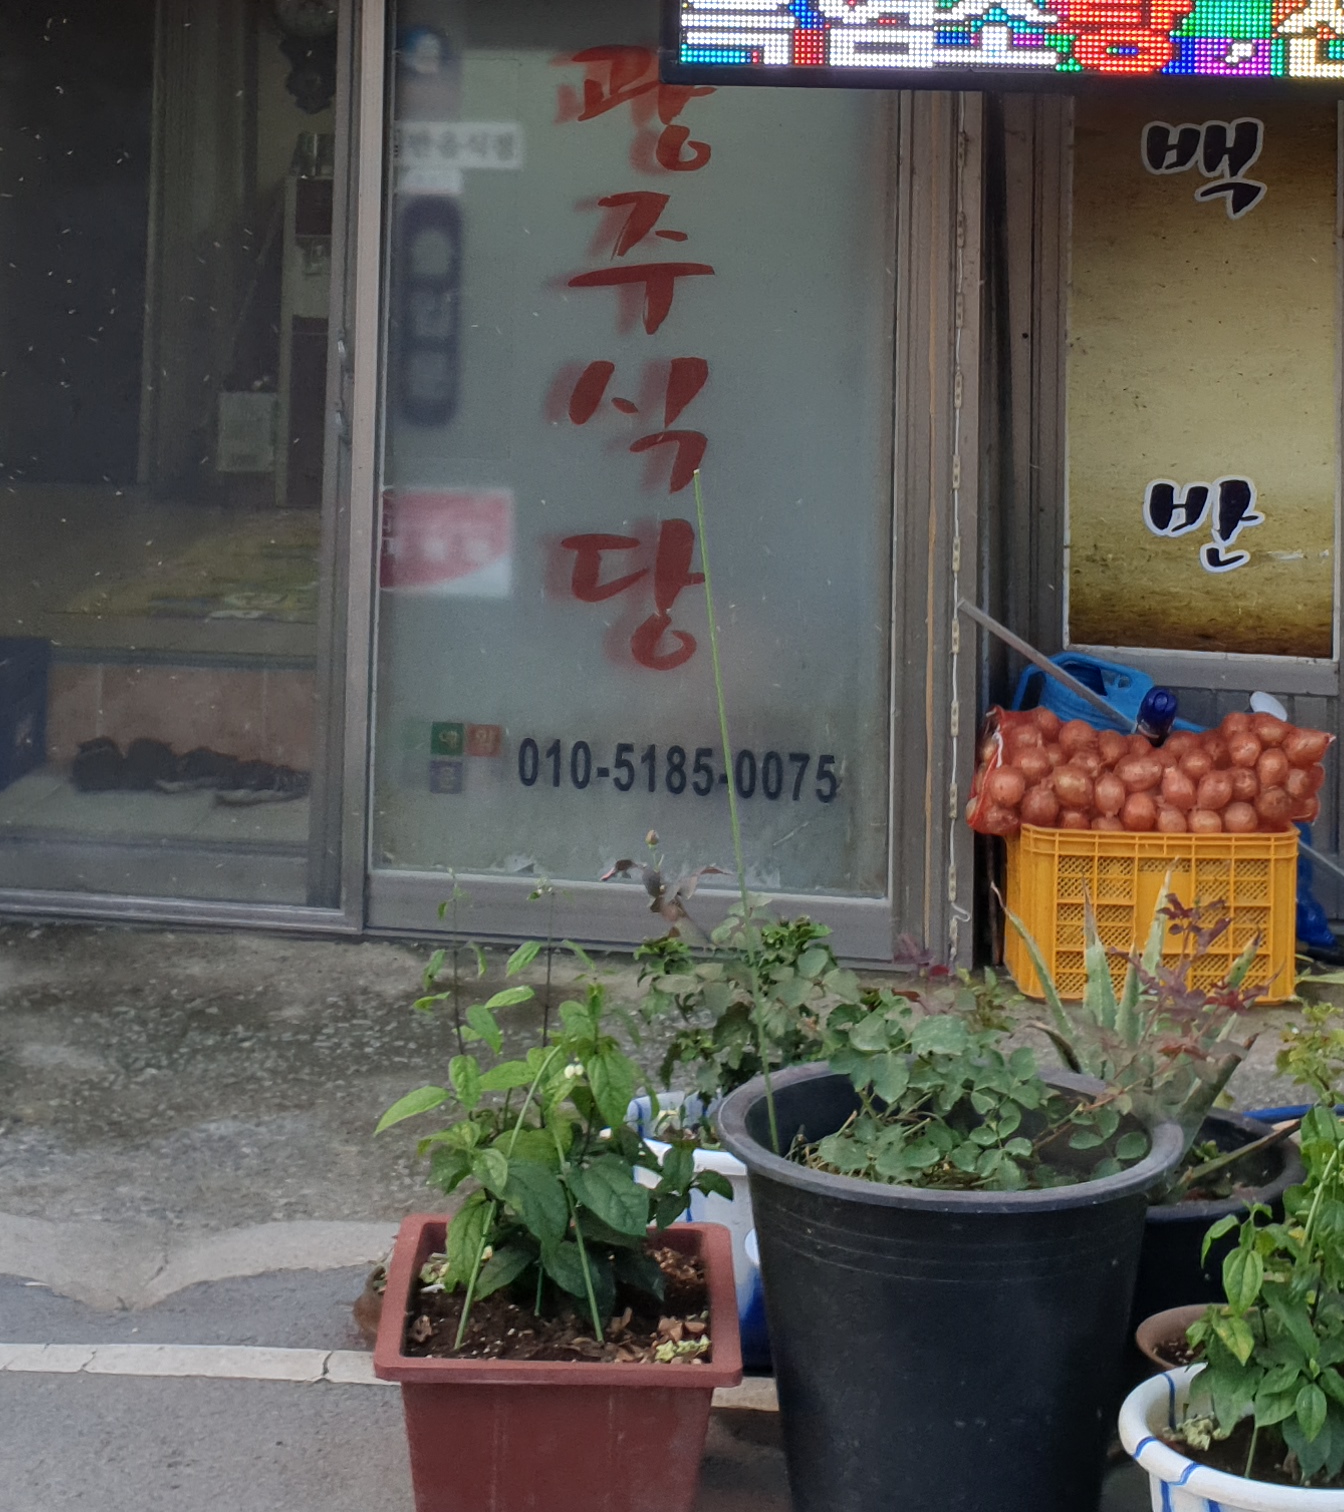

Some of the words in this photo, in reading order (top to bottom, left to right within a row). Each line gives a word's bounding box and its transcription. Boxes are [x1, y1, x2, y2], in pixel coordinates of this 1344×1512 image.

[561, 44, 716, 672] 광주식당
[1142, 117, 1267, 573] 백반
[517, 736, 839, 804] 010-5185-0075
